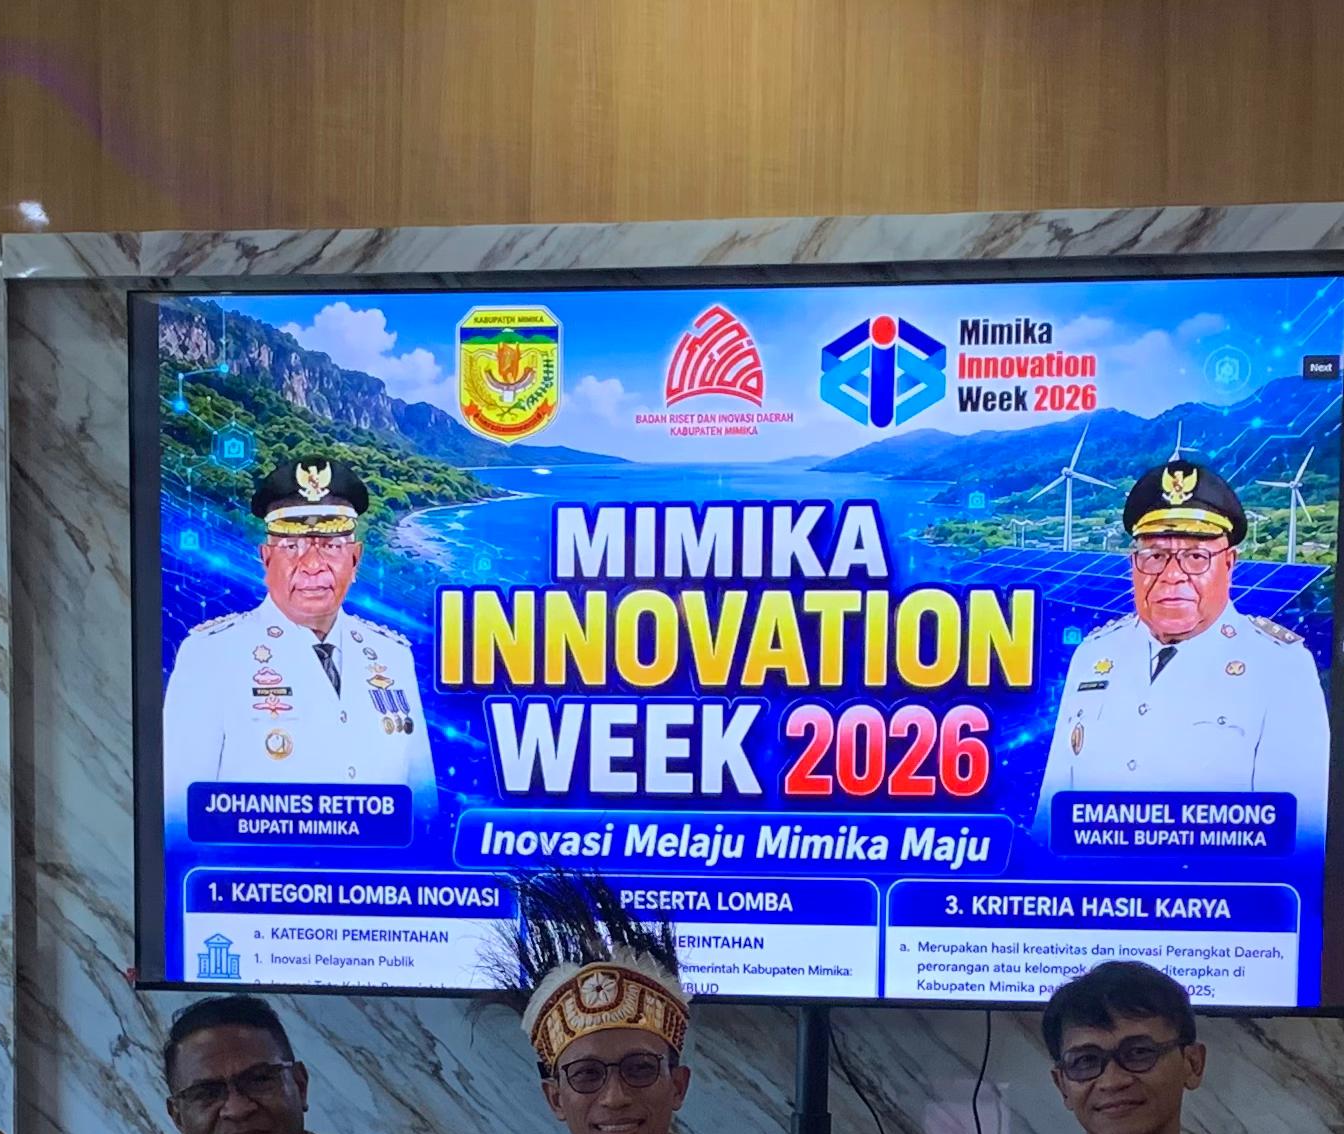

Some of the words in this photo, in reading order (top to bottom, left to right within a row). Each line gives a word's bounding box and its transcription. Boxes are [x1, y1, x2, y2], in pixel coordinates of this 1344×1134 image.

[960, 318, 1052, 345] Mimika
[959, 353, 1097, 378] Innovation
[1310, 363, 1332, 372] Next
[959, 387, 1028, 412] Week
[1034, 386, 1097, 411] 2026
[636, 415, 666, 424] BADAN
[669, 415, 695, 424] RISET
[697, 414, 716, 423] DAN
[718, 414, 754, 423] INOVASI
[757, 413, 793, 422] DAERAH
[670, 427, 722, 436] KABUPATEN
[725, 426, 758, 435] MIMIKA
[557, 505, 888, 578] MIMIKA
[440, 588, 1035, 687] INNOVATION
[492, 703, 762, 794] WEEK
[785, 704, 990, 796] 2026
[205, 793, 313, 814] JOHANNES
[318, 795, 395, 815] RETTOB
[1072, 803, 1176, 824] EMANUEL
[1181, 804, 1276, 825] KEMONG
[238, 818, 293, 834] BUPATI
[298, 819, 360, 835] MIMIKA
[480, 821, 614, 857] Inovasi
[624, 823, 745, 867] Melaju
[755, 824, 889, 861] Mimika
[900, 826, 991, 870] Maju
[1074, 829, 1129, 845] WAKIL
[1134, 829, 1195, 846] BUPATI
[1200, 830, 1267, 847] MIMIKA
[208, 882, 224, 902] 1.
[231, 882, 333, 904] KATEGORI
[338, 884, 413, 905] LOMBA
[417, 886, 499, 907] INOVASI
[620, 890, 711, 911] PESERTA
[717, 891, 793, 912] LOMBA
[945, 894, 964, 915] 3.
[972, 895, 1075, 917] KRITERIA
[1081, 896, 1149, 918] HASIL
[1155, 897, 1231, 919] KARYA
[253, 929, 265, 940] a.
[271, 927, 338, 941] KATEGORI
[342, 928, 449, 943] PEMERINTAHAN
[673, 935, 764, 950] ERINTAHAN
[899, 943, 911, 953] a.
[917, 941, 988, 956] Merupakan
[991, 941, 1020, 954] hasil
[1023, 942, 1088, 956] kreativitas
[1091, 943, 1115, 956] dan
[1118, 946, 1162, 957] inovasi
[1166, 944, 1231, 960] Perangkat
[1234, 946, 1284, 960] Daerah,
[254, 953, 263, 965] 1.
[270, 952, 311, 965] Inovasi
[314, 954, 375, 969] Pelayanan
[378, 955, 415, 967] Publik
[917, 962, 990, 976] perorangan
[993, 962, 1021, 973] atau
[1024, 962, 1086, 976] kelompok
[742, 963, 805, 978] Kabupaten
[808, 964, 853, 977] Mimika:
[1161, 964, 1229, 979] diterapkan
[1232, 966, 1245, 978] di
[917, 979, 986, 993] Kabupaten
[989, 980, 1035, 993] Mimika
[1187, 983, 1216, 998] 025;
